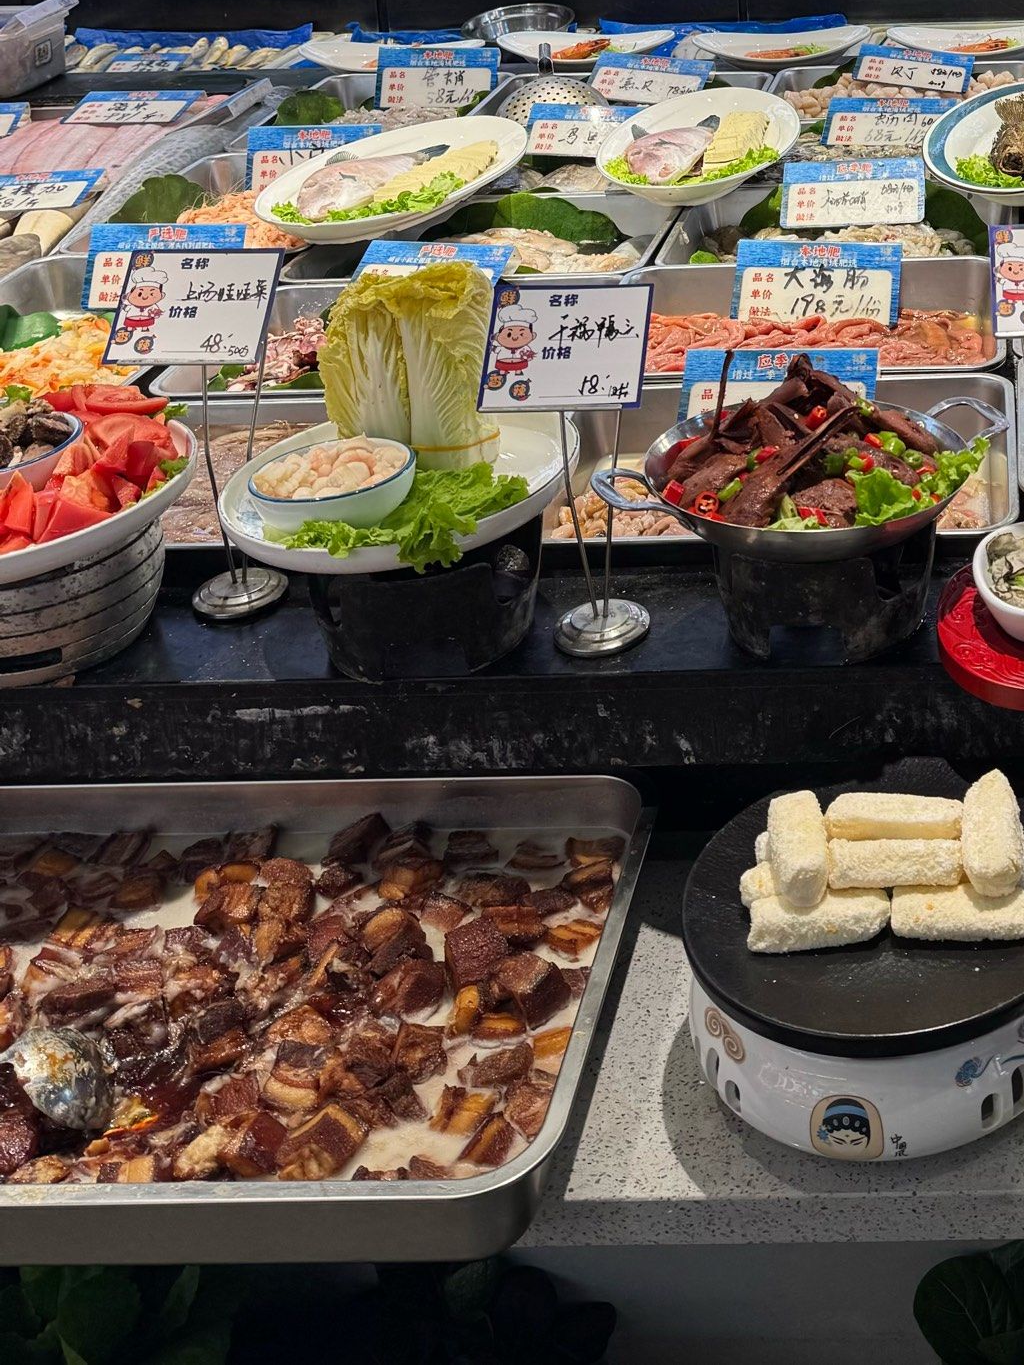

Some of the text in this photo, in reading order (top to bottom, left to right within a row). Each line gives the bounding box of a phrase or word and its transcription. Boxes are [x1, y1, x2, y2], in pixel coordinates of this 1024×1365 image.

[260, 155, 278, 164] 品名
[260, 169, 277, 178] 单价
[147, 227, 188, 241] 严选肥
[418, 244, 456, 257] 严选肥
[799, 245, 841, 259] 本地肥
[103, 258, 124, 267] 品名
[180, 258, 210, 270] 名称
[100, 274, 121, 284] 单价
[752, 272, 775, 282] 品名
[99, 291, 120, 302] 做法
[549, 293, 579, 307] 名称
[750, 288, 773, 300] 单价
[169, 306, 198, 319] 价格
[748, 306, 771, 318] 做法
[541, 346, 571, 360] 价格
[756, 353, 792, 370] 应季
